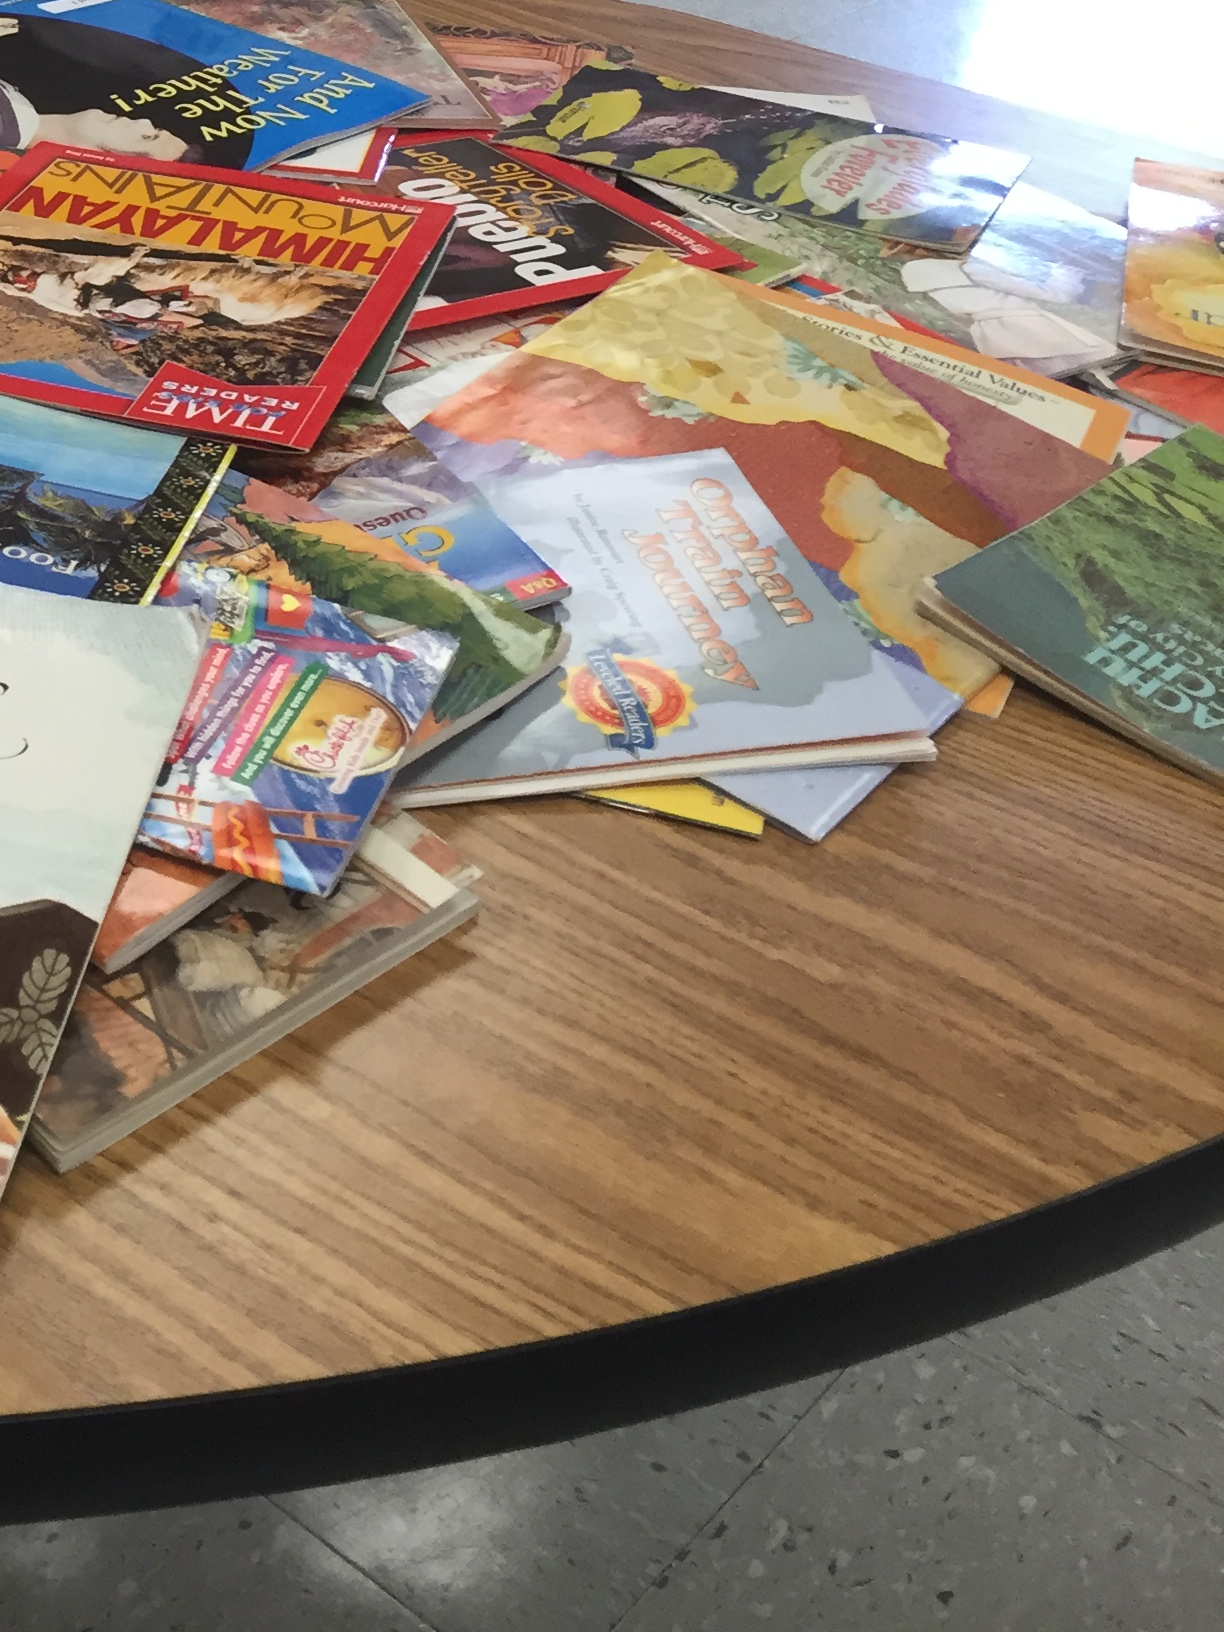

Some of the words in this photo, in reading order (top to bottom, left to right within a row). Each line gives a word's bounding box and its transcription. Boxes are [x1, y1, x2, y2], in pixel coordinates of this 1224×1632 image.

[109, 46, 292, 112] Weather!
[174, 89, 265, 118] The
[257, 64, 325, 94] For
[294, 72, 377, 114] And
[200, 103, 310, 142] Now
[48, 158, 417, 243] MOUNTAINS
[337, 194, 406, 214] Harcourt
[400, 147, 575, 239] Storyteller
[489, 161, 578, 206] Dolls
[9, 185, 398, 276] HIMALAYAN
[397, 177, 605, 287] Pueblo
[161, 380, 301, 410] READERS
[868, 333, 898, 351] &
[900, 344, 983, 381] Essential
[988, 372, 1047, 404] Values
[940, 370, 958, 383] of
[960, 374, 1015, 403] honesty
[142, 398, 284, 435] TIME
[655, 499, 751, 612] Train
[690, 476, 814, 629] Orphan
[620, 528, 761, 691] Journey
[198, 715, 220, 743] hidden
[216, 694, 238, 720] things
[589, 652, 629, 697] Leveled
[619, 692, 648, 745] Readers
[222, 745, 243, 771] Follow
[243, 711, 262, 733] clues
[240, 762, 258, 780] And
[269, 707, 294, 738] discover
[289, 691, 305, 710] even
